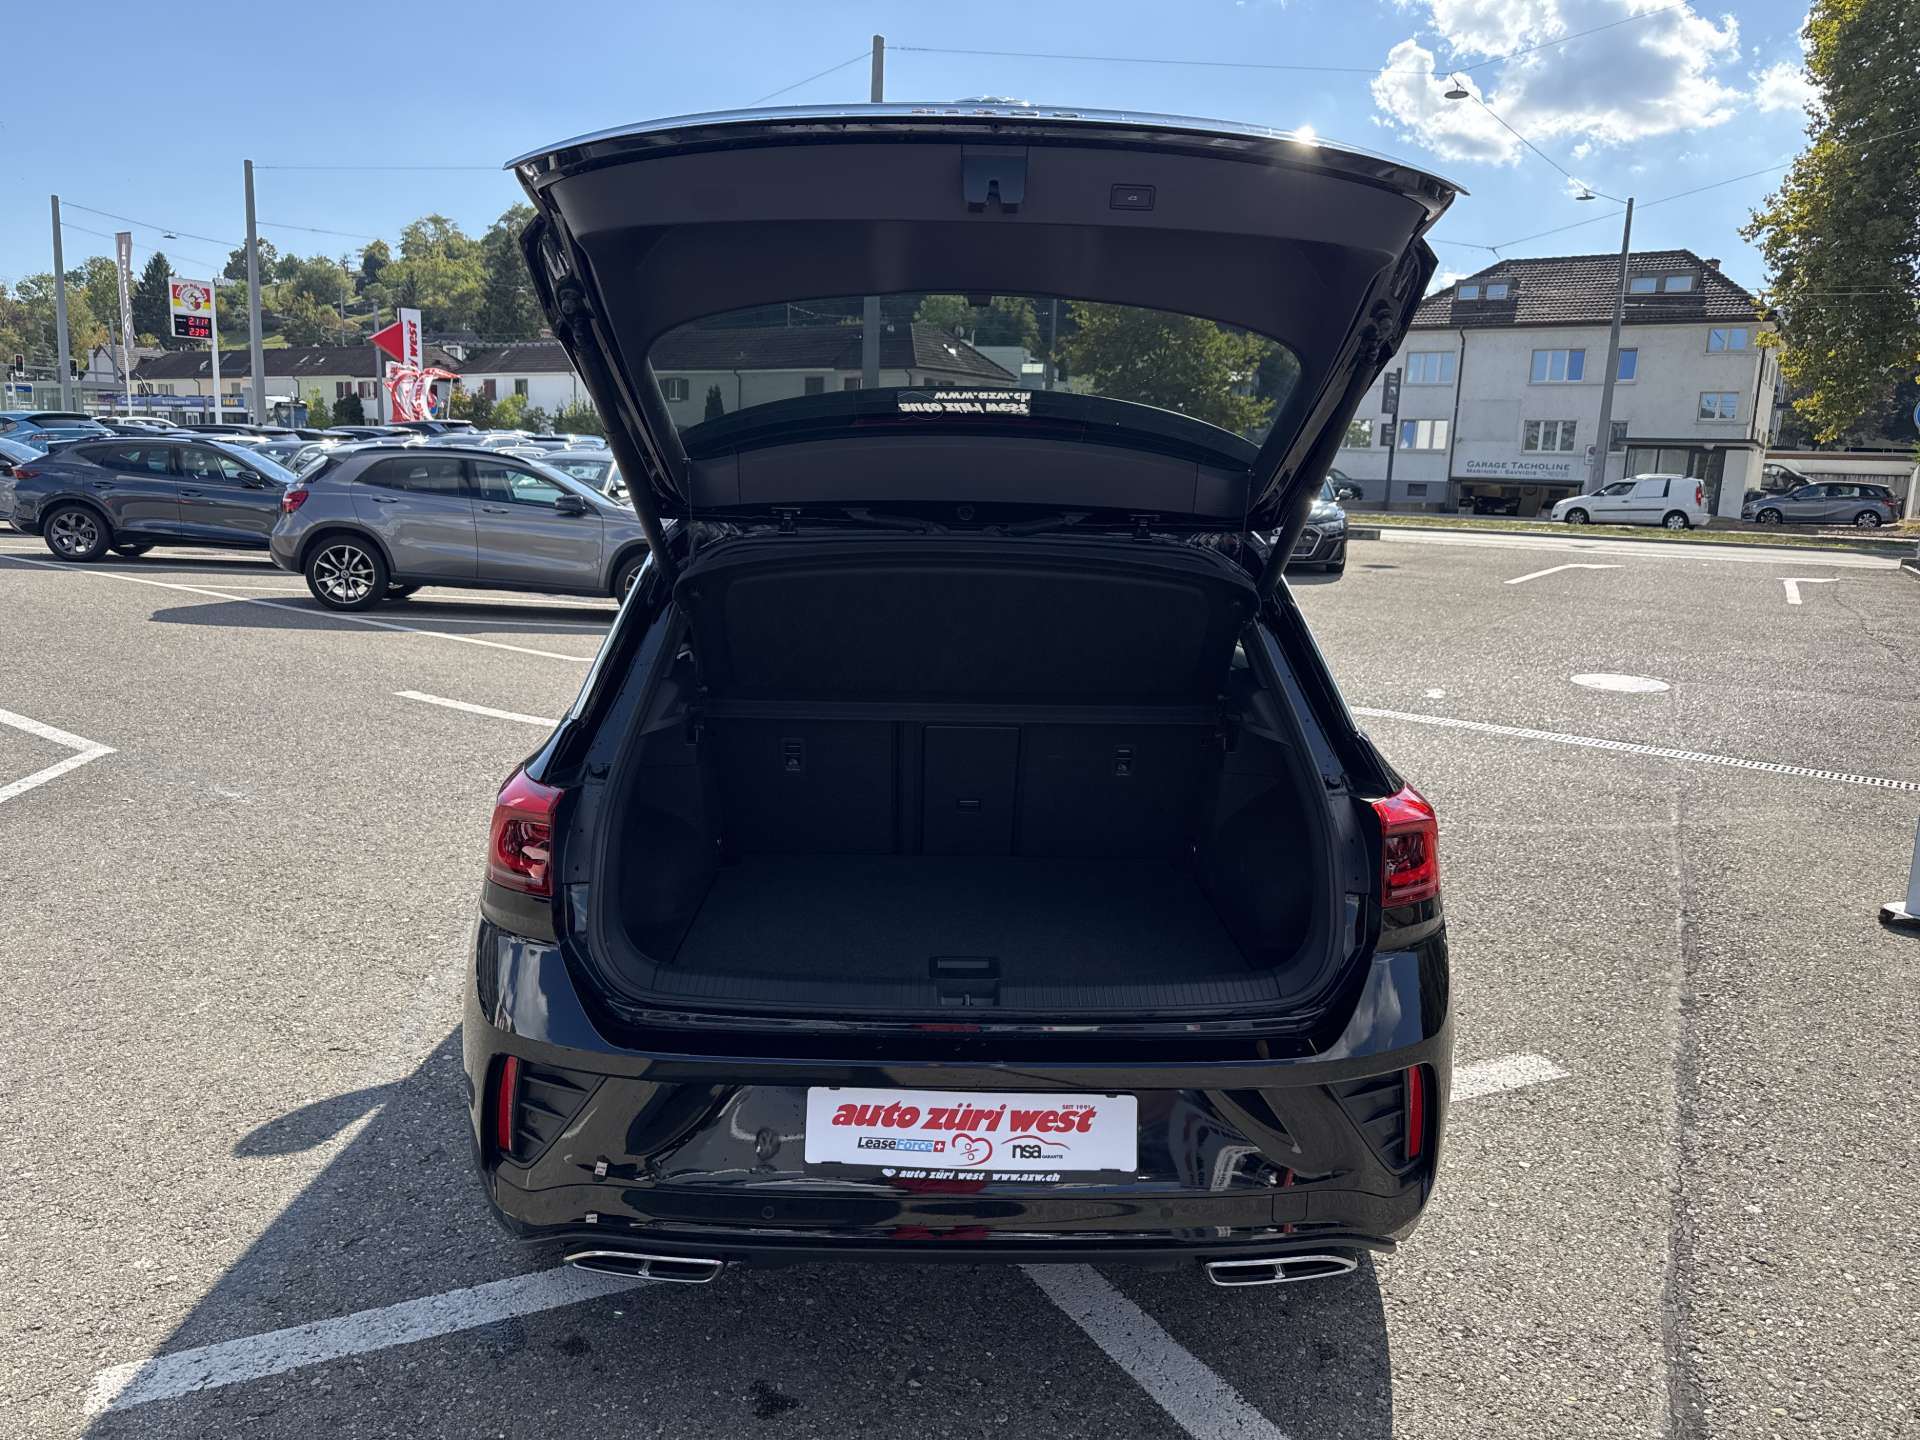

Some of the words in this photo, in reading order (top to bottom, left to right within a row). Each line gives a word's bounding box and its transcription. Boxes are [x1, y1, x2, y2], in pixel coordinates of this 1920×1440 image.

[408, 321, 418, 357] west
[1467, 460, 1508, 469] GARAGE
[1511, 461, 1571, 471] TACHOLINE
[832, 1100, 920, 1128] auto
[921, 1102, 1009, 1132] züri
[1010, 1105, 1097, 1133] west
[857, 1136, 934, 1153] LeaseForce
[1011, 1143, 1042, 1159] nsa
[899, 1169, 927, 1180] auto
[928, 1169, 955, 1181] züri
[957, 1171, 986, 1181] west
